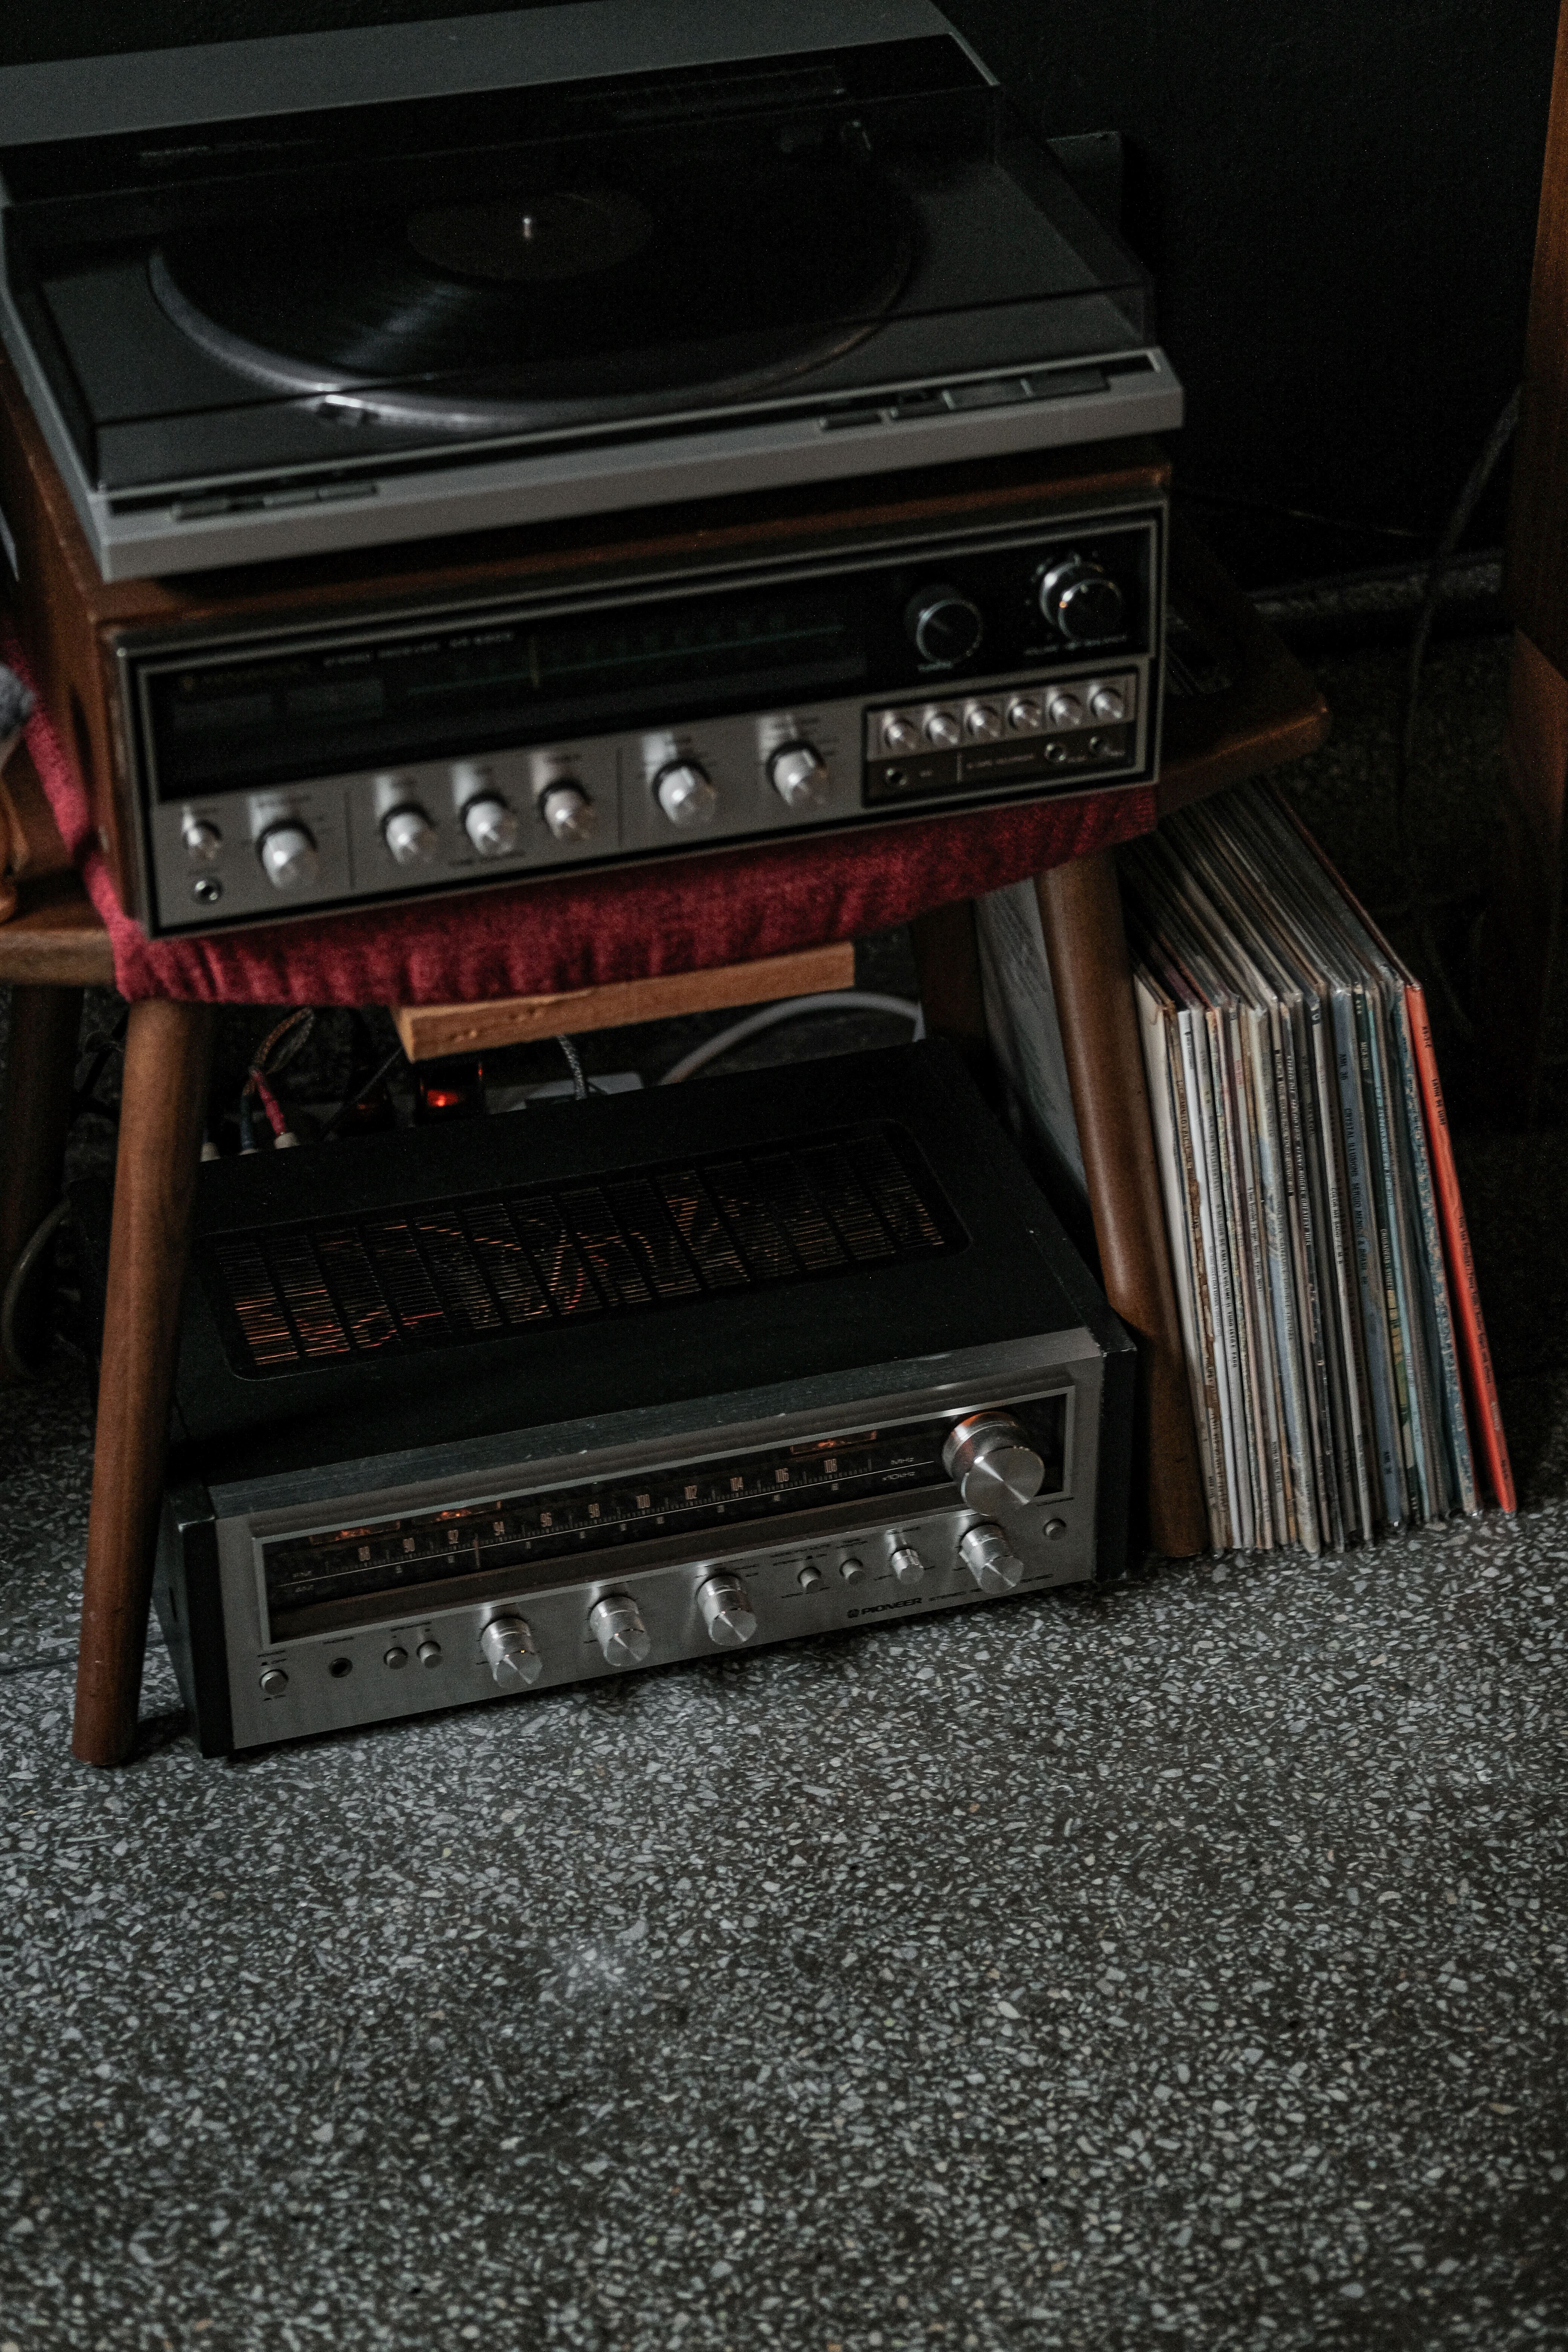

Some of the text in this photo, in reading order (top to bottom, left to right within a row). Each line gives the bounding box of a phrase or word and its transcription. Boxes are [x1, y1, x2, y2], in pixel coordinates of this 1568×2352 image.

[1343, 1108, 1354, 1138] CRYSTAL
[1347, 1142, 1359, 1177] ILLUSIONS
[1333, 1209, 1339, 1219] ME
[890, 1457, 914, 1465] MHz
[540, 1511, 552, 1527] 96
[861, 1597, 922, 1615] PIONEER
